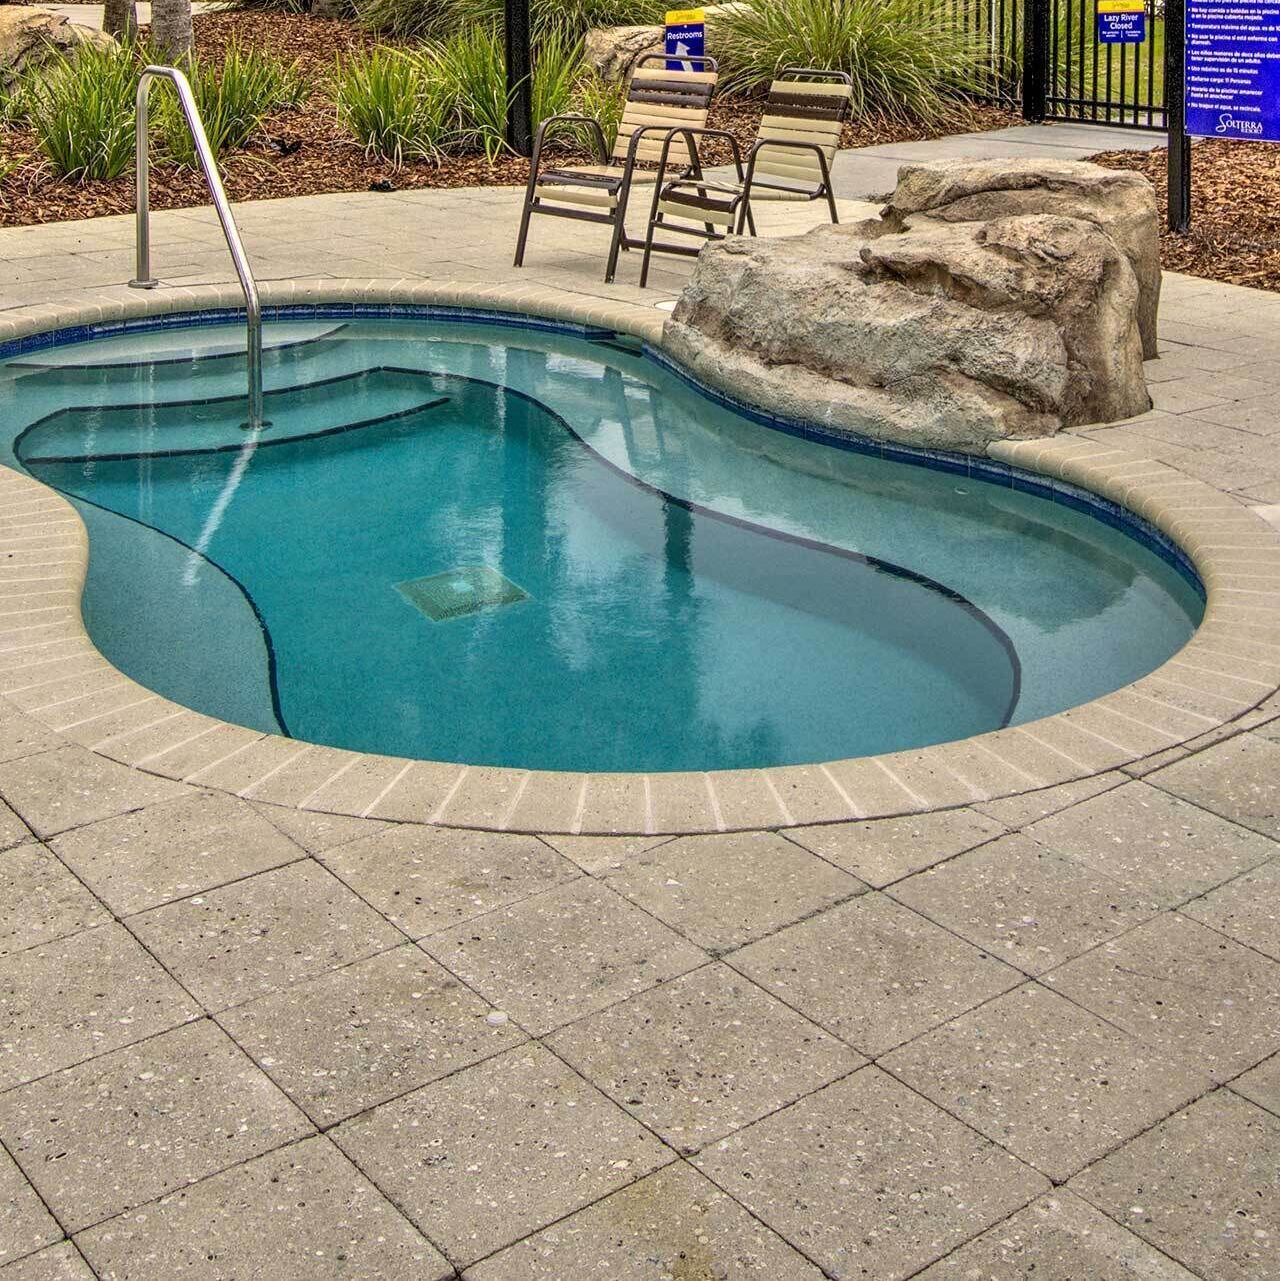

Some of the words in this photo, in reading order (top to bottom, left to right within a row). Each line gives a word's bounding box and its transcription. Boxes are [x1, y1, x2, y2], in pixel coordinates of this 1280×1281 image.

[1104, 14, 1119, 22] Lazy
[667, 31, 703, 40] Restrooms
[1216, 113, 1262, 133] SOLTERRA
